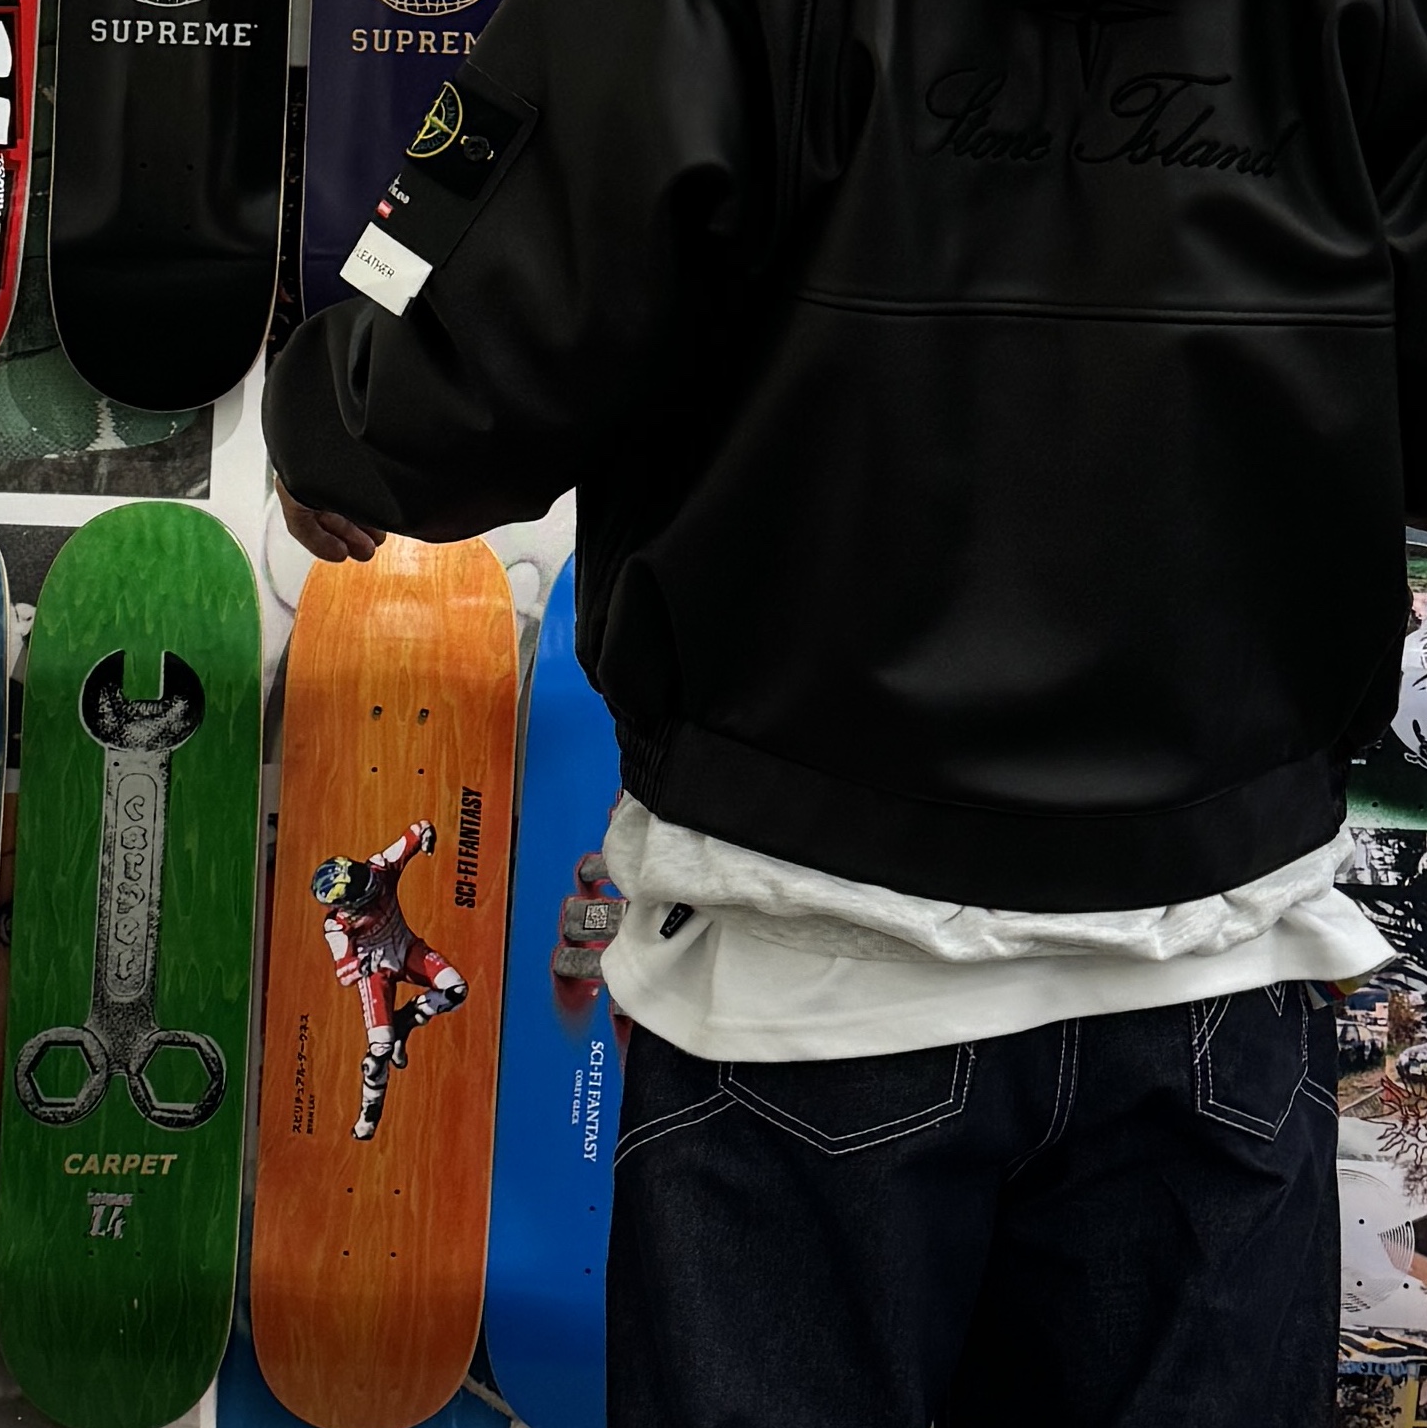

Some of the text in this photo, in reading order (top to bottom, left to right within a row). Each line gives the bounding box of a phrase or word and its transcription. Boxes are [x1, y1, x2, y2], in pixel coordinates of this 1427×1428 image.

[91, 19, 251, 47] SUPREME
[352, 29, 478, 55] SUPREM
[455, 785, 483, 909] SCI-FI FANTASY
[583, 1040, 604, 1162] SCI-FI FANTASY
[64, 1154, 178, 1175] CARPET
